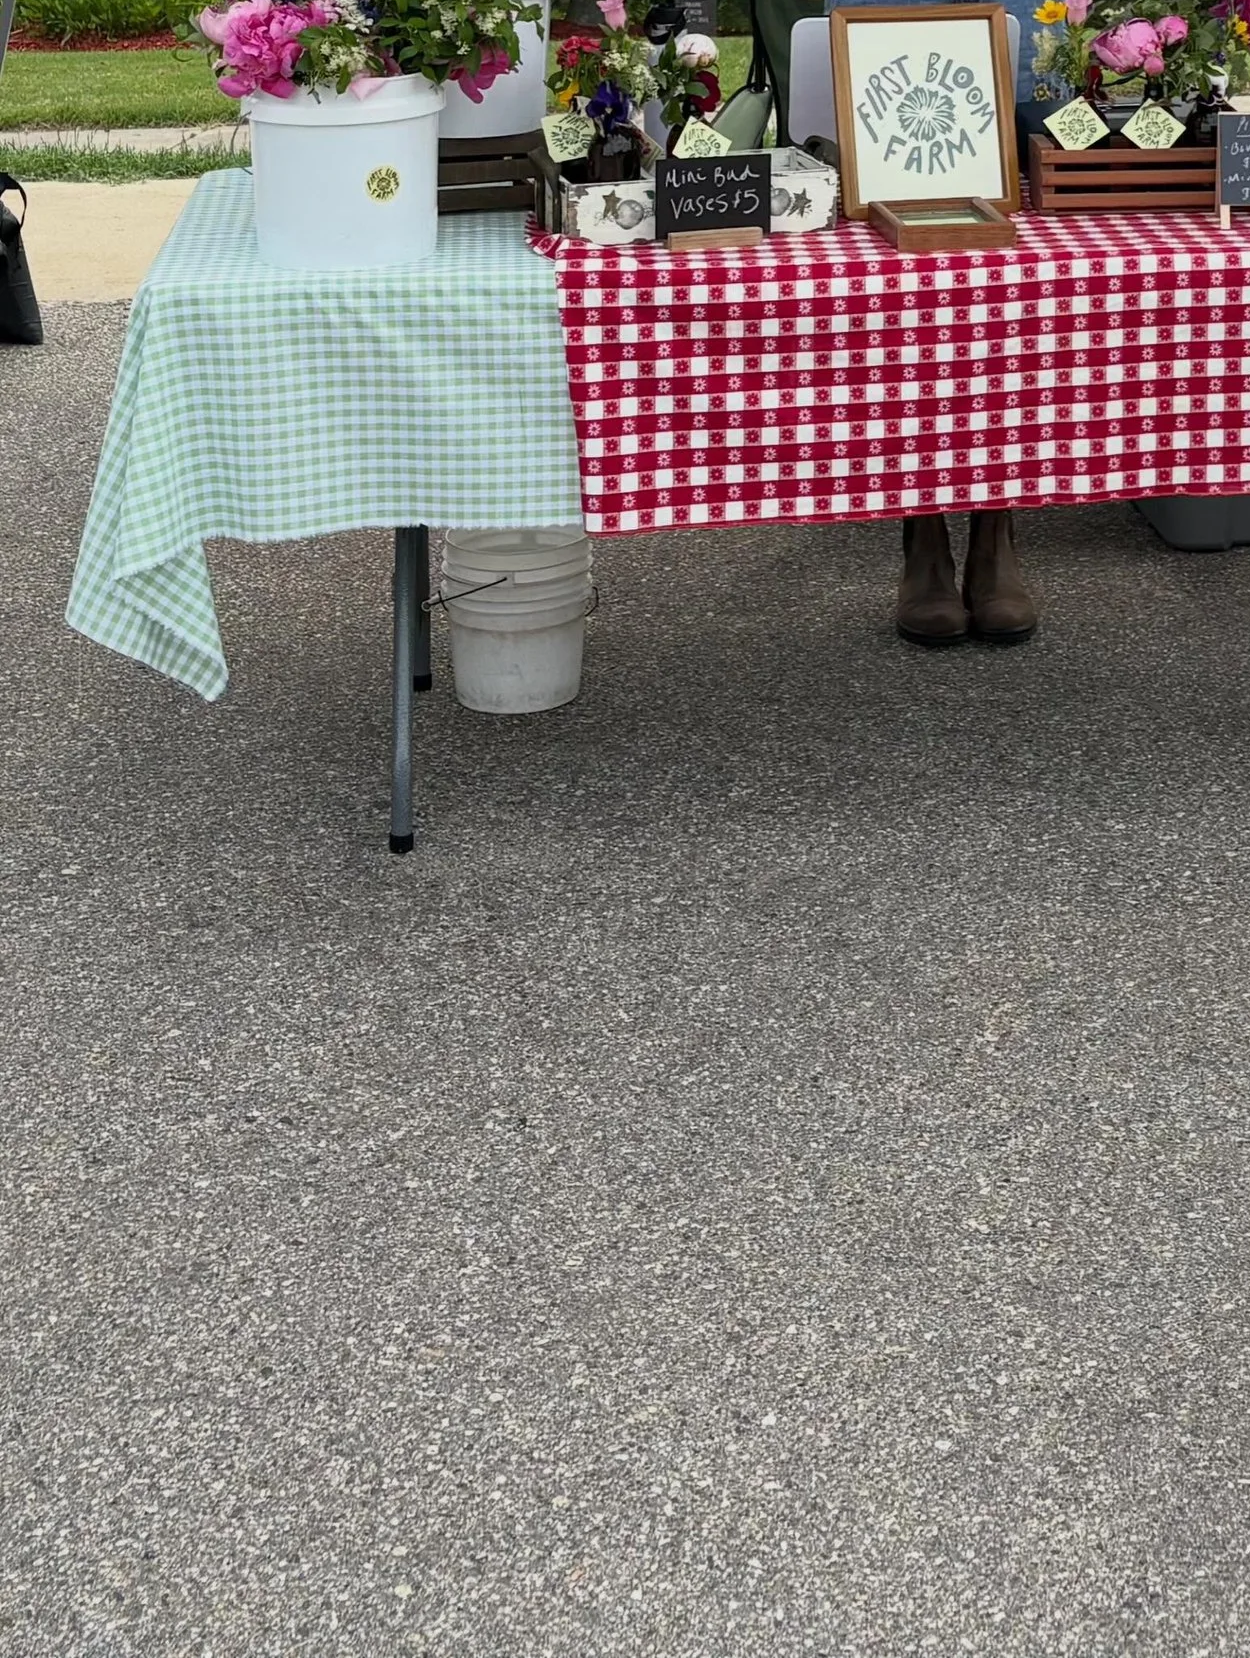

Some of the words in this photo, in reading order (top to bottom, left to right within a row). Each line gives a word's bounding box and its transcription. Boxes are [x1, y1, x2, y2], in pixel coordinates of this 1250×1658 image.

[856, 54, 912, 144] FIRST
[925, 52, 995, 135] BLOOM
[883, 128, 977, 176] FARM
[665, 167, 707, 188] Mini
[714, 164, 761, 188] Bud
[732, 188, 760, 215] $5
